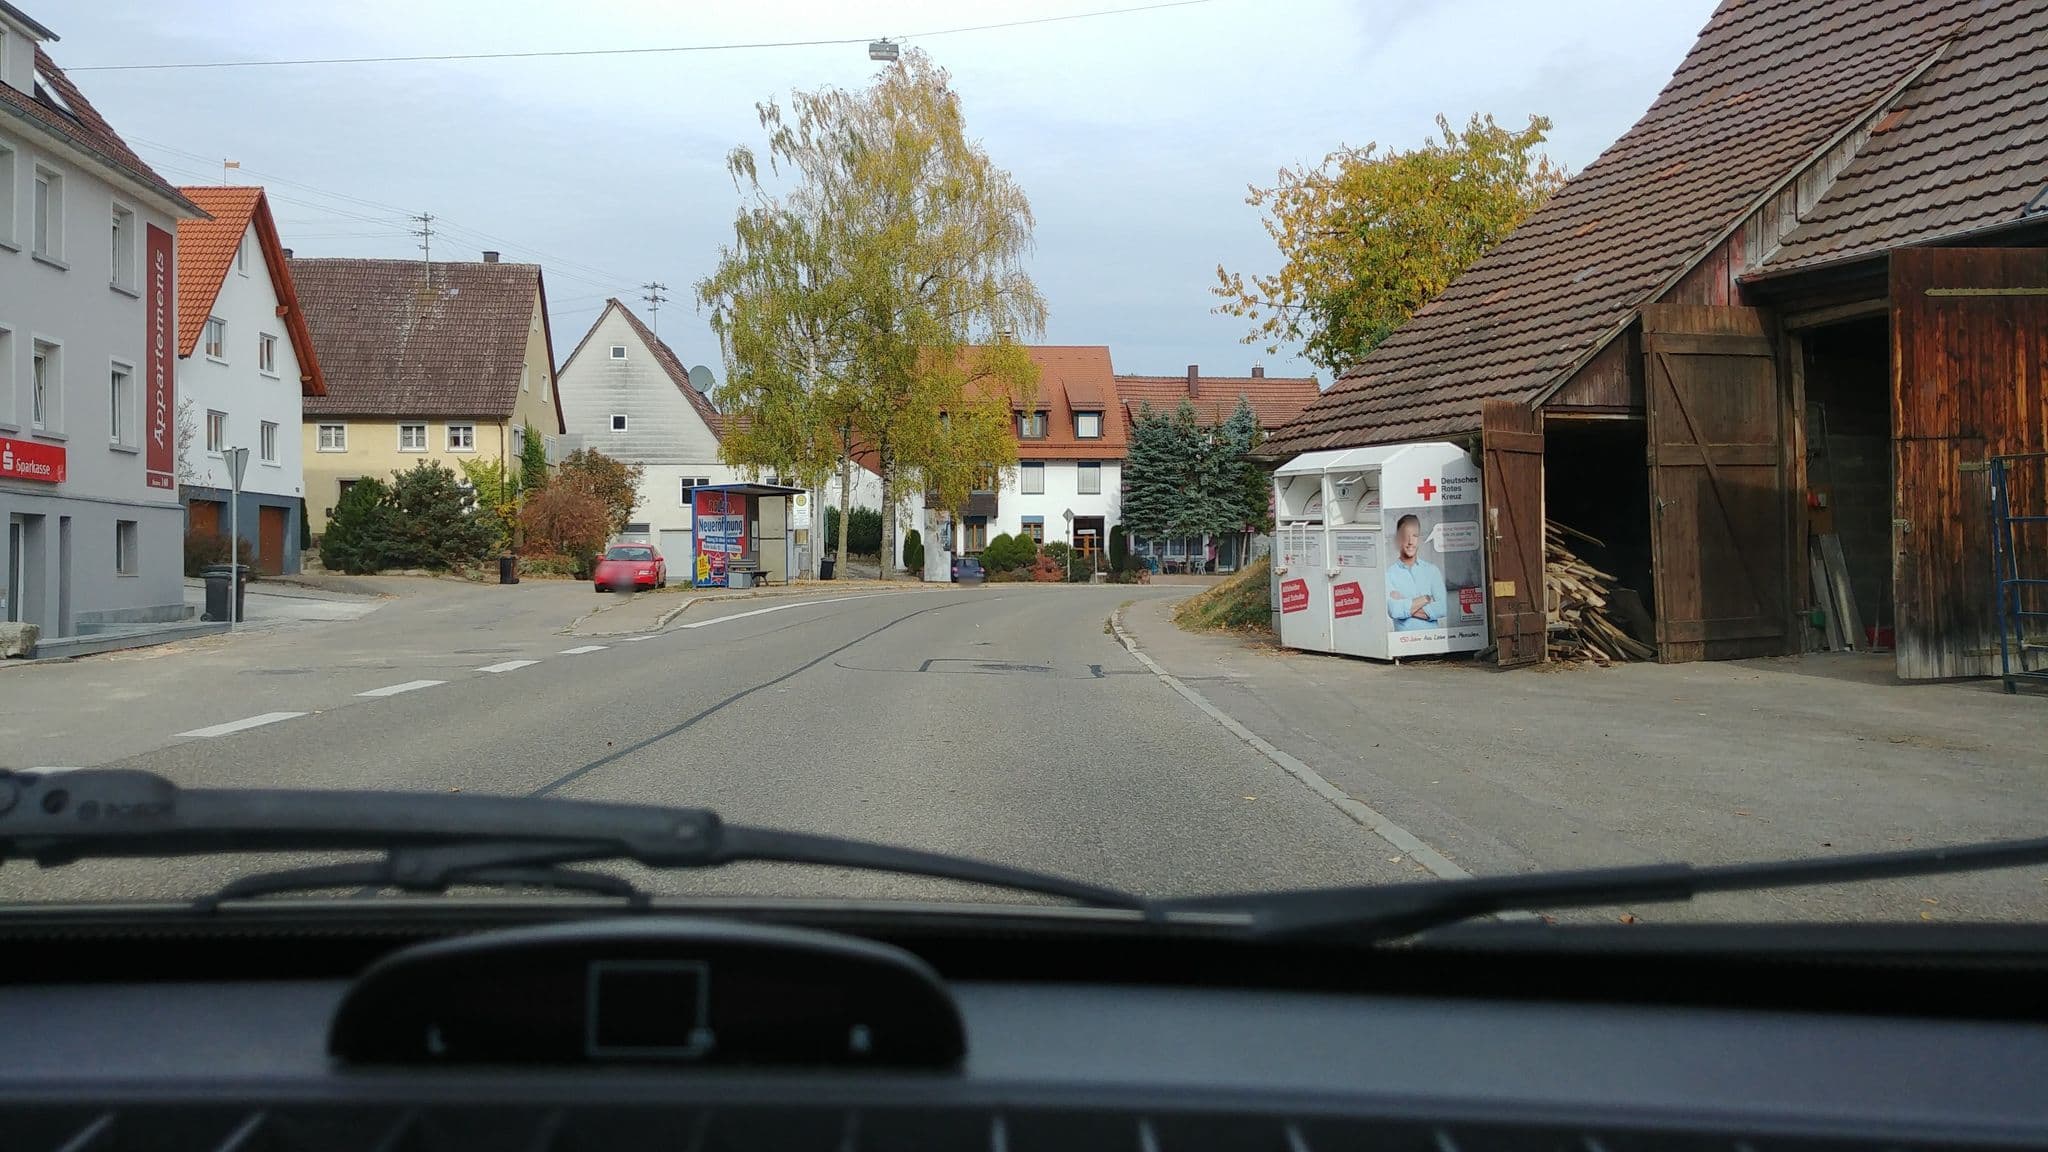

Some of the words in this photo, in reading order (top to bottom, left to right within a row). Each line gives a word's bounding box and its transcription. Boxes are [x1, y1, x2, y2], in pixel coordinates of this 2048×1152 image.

[153, 250, 166, 450] Appartements
[16, 458, 51, 475] Sparkasse
[698, 516, 743, 534] Neueröfnung
